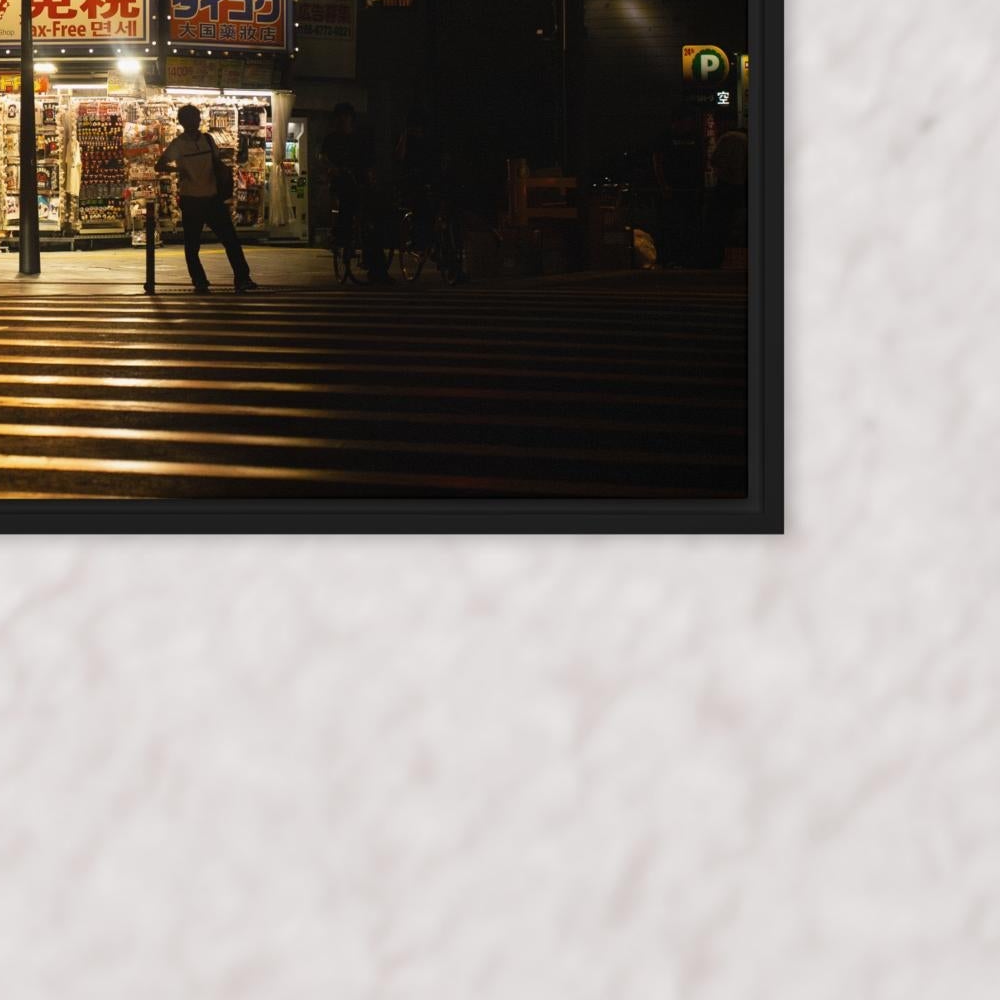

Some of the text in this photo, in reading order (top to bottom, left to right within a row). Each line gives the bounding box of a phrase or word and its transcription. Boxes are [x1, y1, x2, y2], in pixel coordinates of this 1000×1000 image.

[30, 21, 86, 37] ax-Free
[700, 54, 720, 81] P
[716, 90, 730, 105] 空
